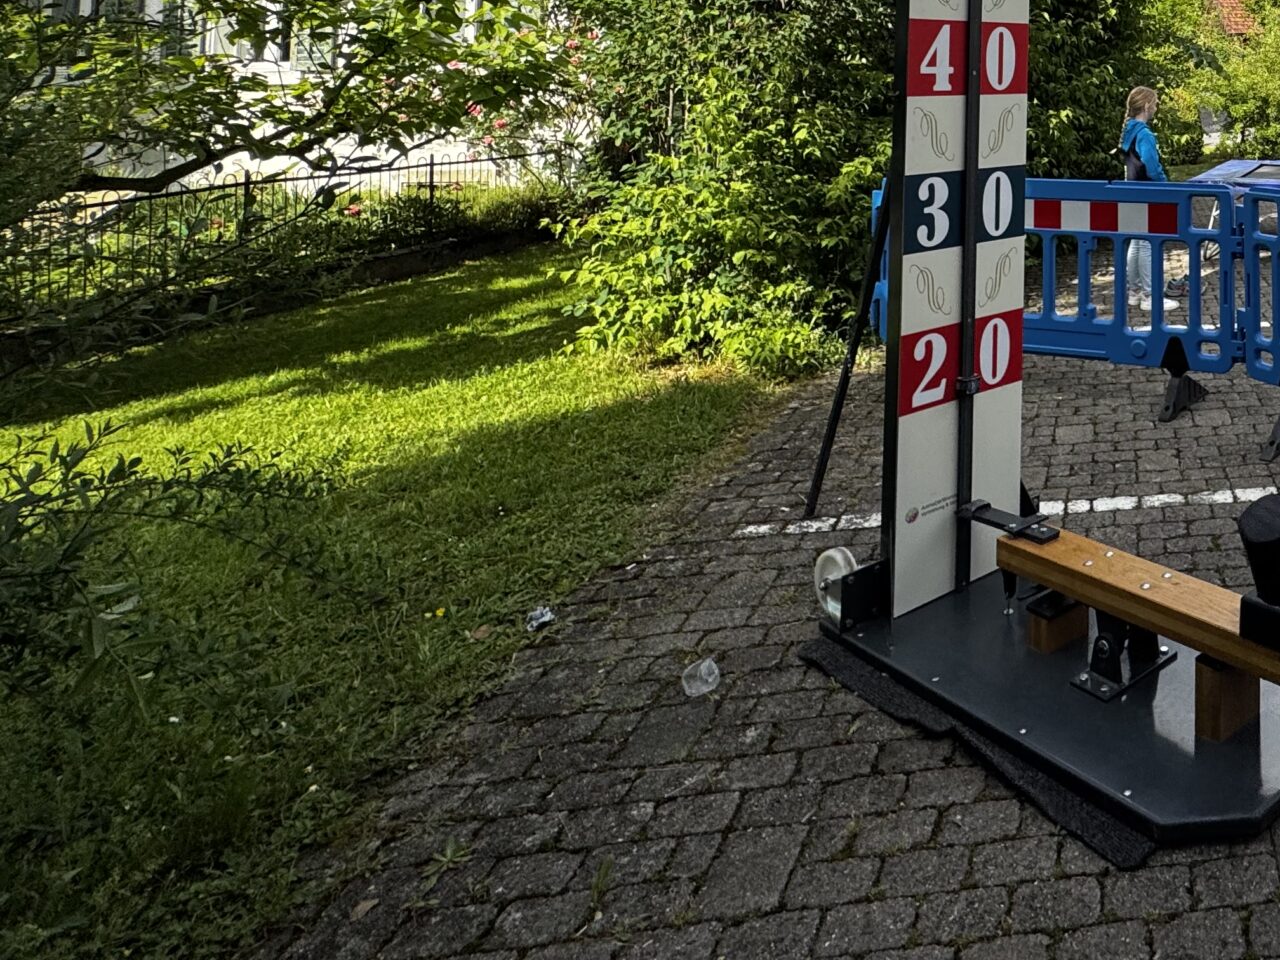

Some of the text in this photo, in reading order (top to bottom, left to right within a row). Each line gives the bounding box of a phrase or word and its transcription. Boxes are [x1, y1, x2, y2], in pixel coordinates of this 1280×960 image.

[920, 24, 1016, 91] 40
[916, 171, 1013, 248] 30
[911, 318, 1011, 409] 20
